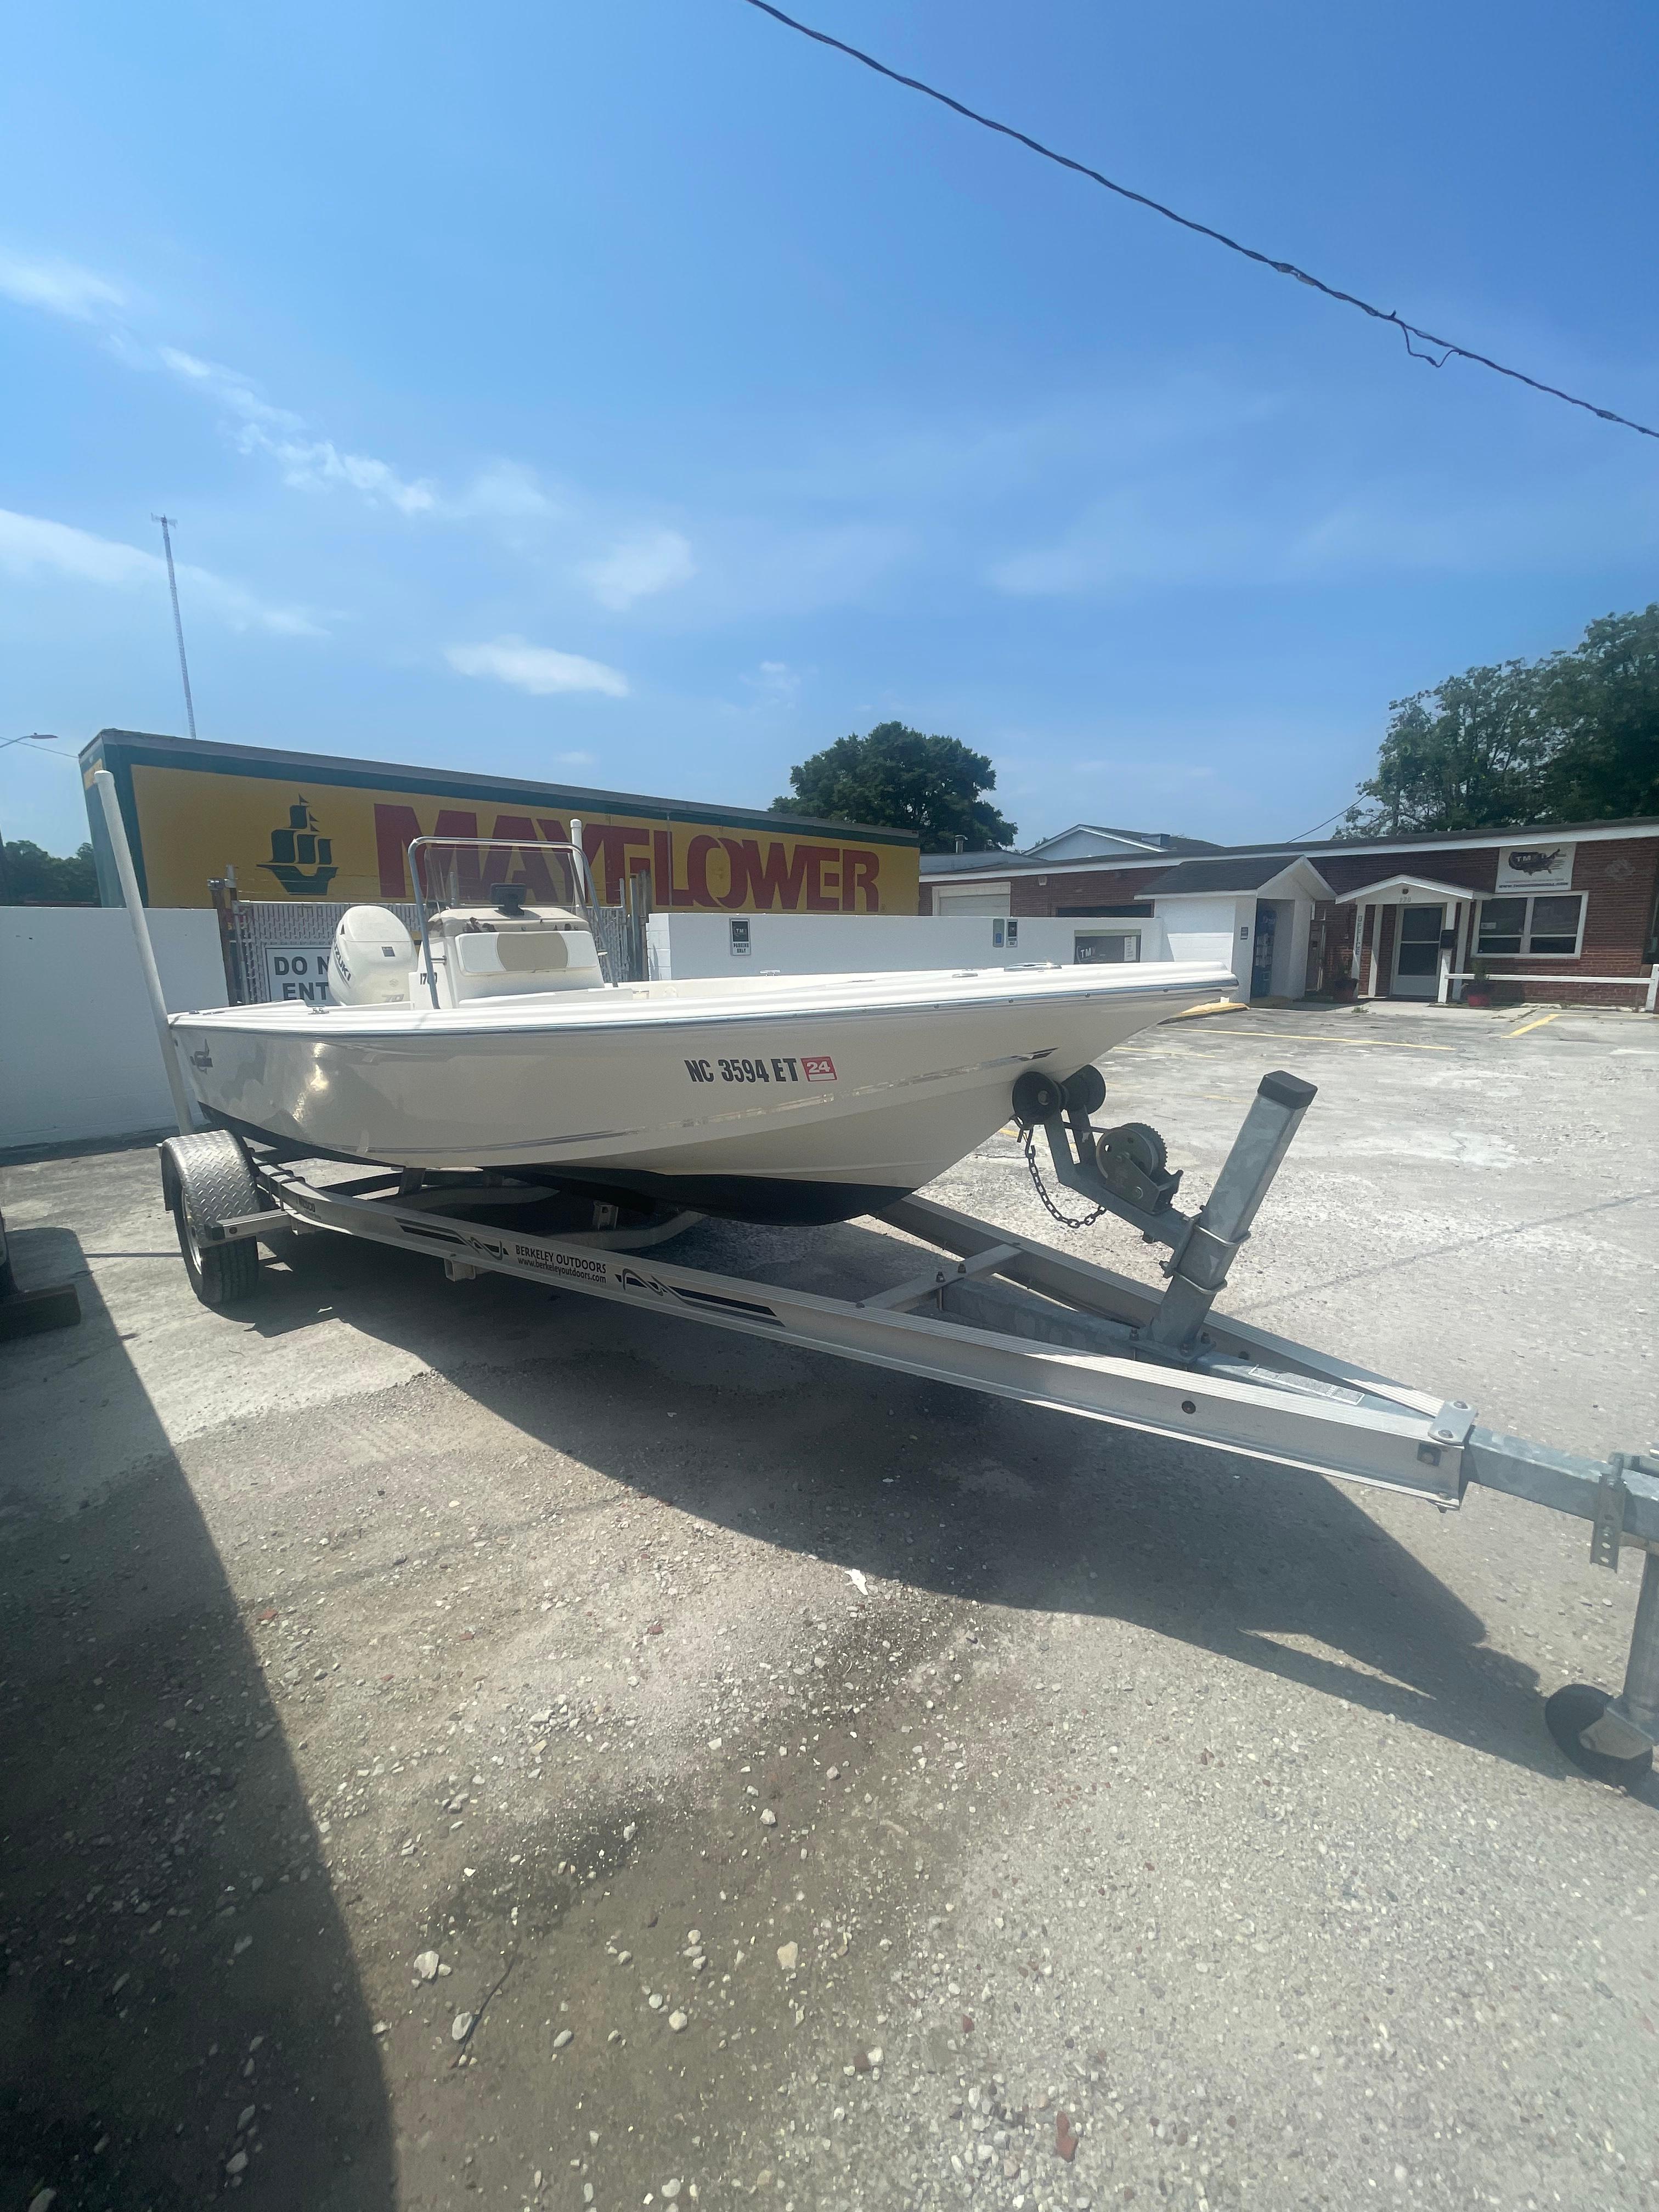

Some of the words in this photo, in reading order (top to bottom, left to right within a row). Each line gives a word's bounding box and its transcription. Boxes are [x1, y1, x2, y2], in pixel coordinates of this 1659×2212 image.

[374, 803, 879, 912] MAYFLOWER
[274, 956, 308, 975] DO
[420, 972, 437, 985] 170
[282, 981, 329, 1001] ENT
[684, 1059, 714, 1082] NC
[718, 1059, 770, 1082] 3594
[771, 1058, 799, 1081] ET
[806, 1061, 831, 1074] 24
[515, 1244, 554, 1262] BERKELEY
[556, 1254, 606, 1274] OUTDOORS
[517, 1257, 606, 1283] www.berkeleyoutdoors.com
